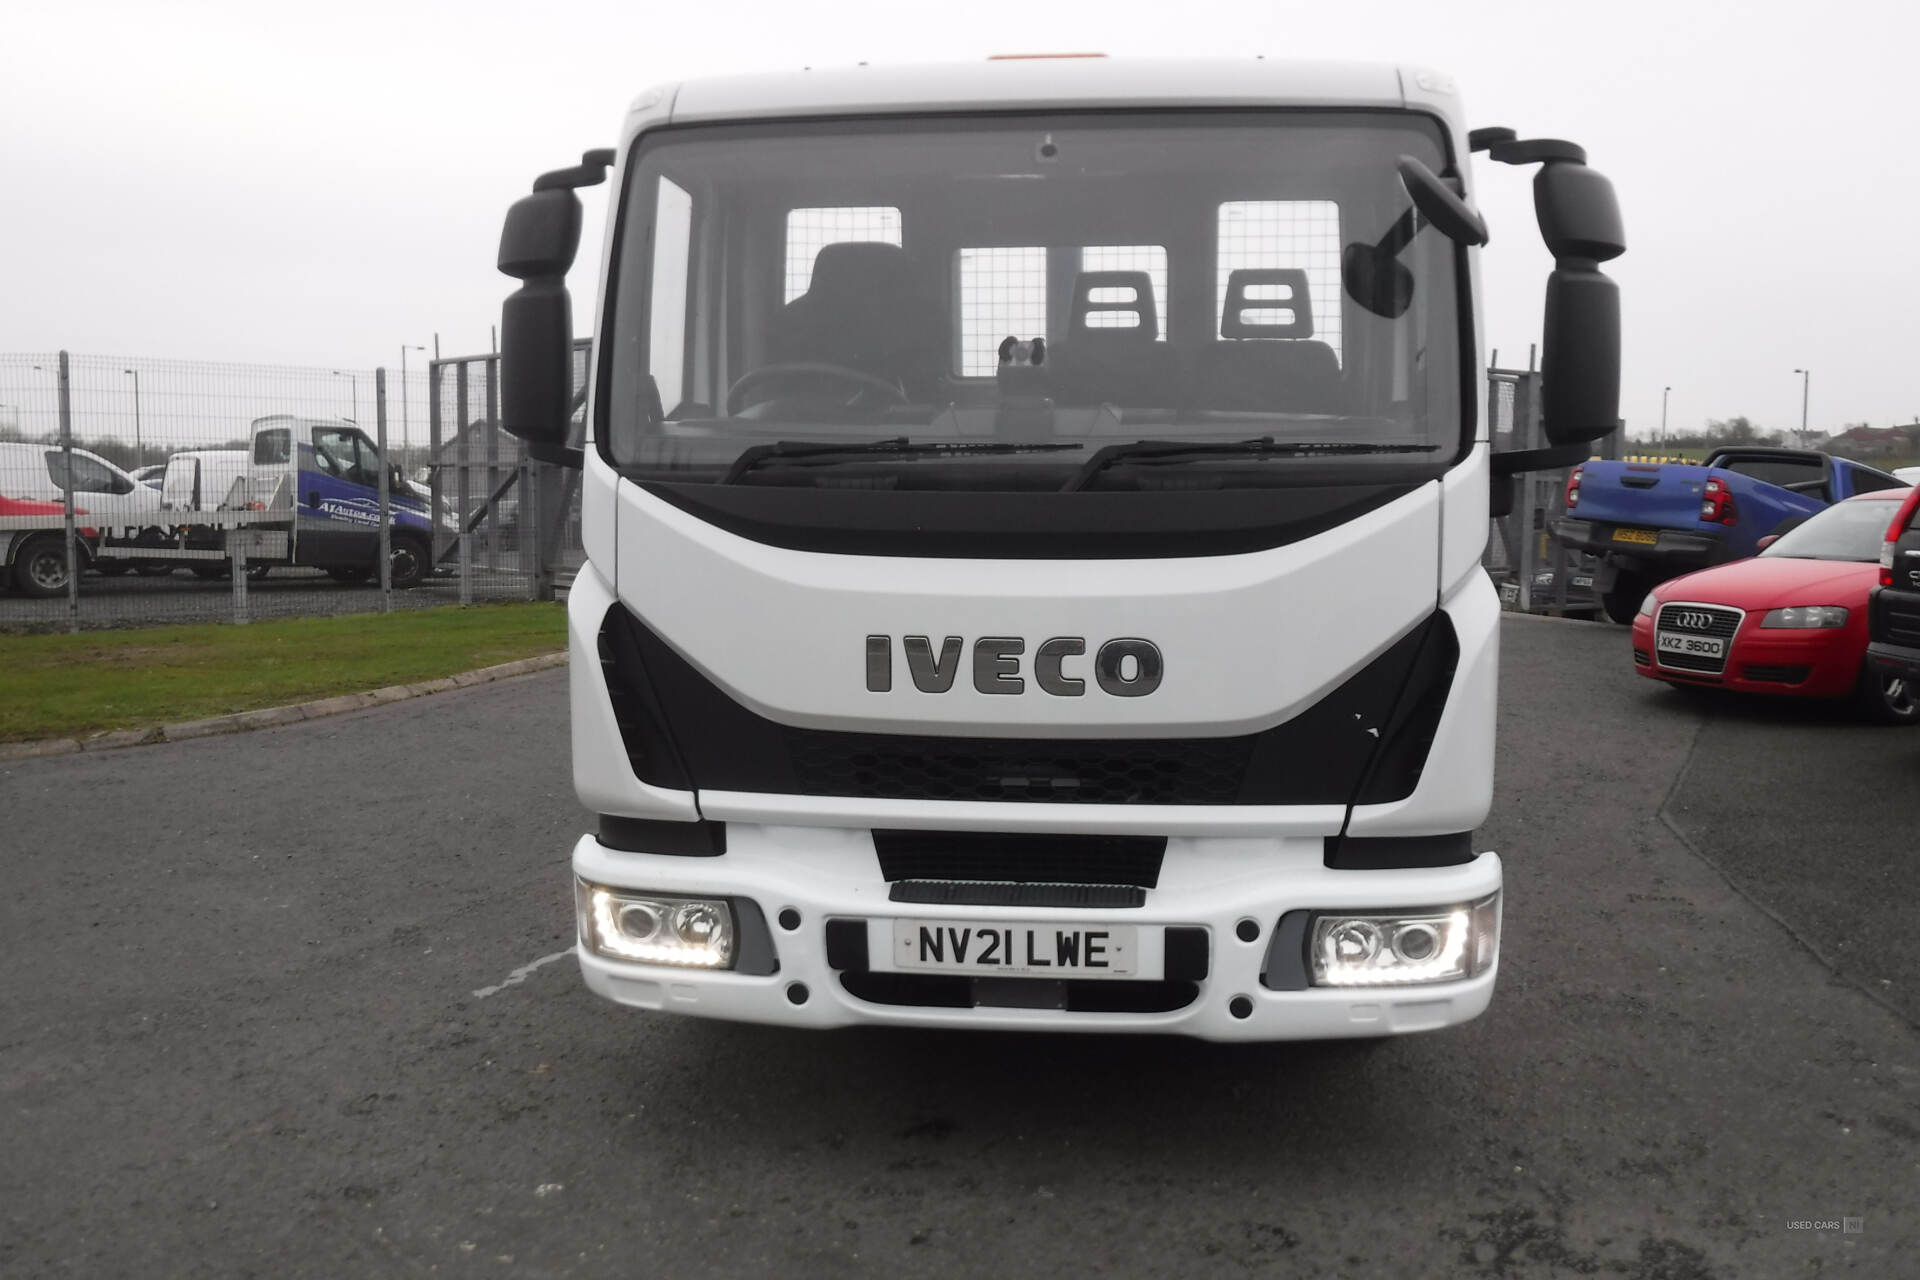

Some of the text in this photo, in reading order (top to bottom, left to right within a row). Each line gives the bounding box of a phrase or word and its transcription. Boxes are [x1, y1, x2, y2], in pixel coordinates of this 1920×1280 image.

[866, 634, 1164, 697] IVECO
[1661, 636, 1720, 654] XKZ 3600
[919, 926, 1110, 967] NV21 LWE
